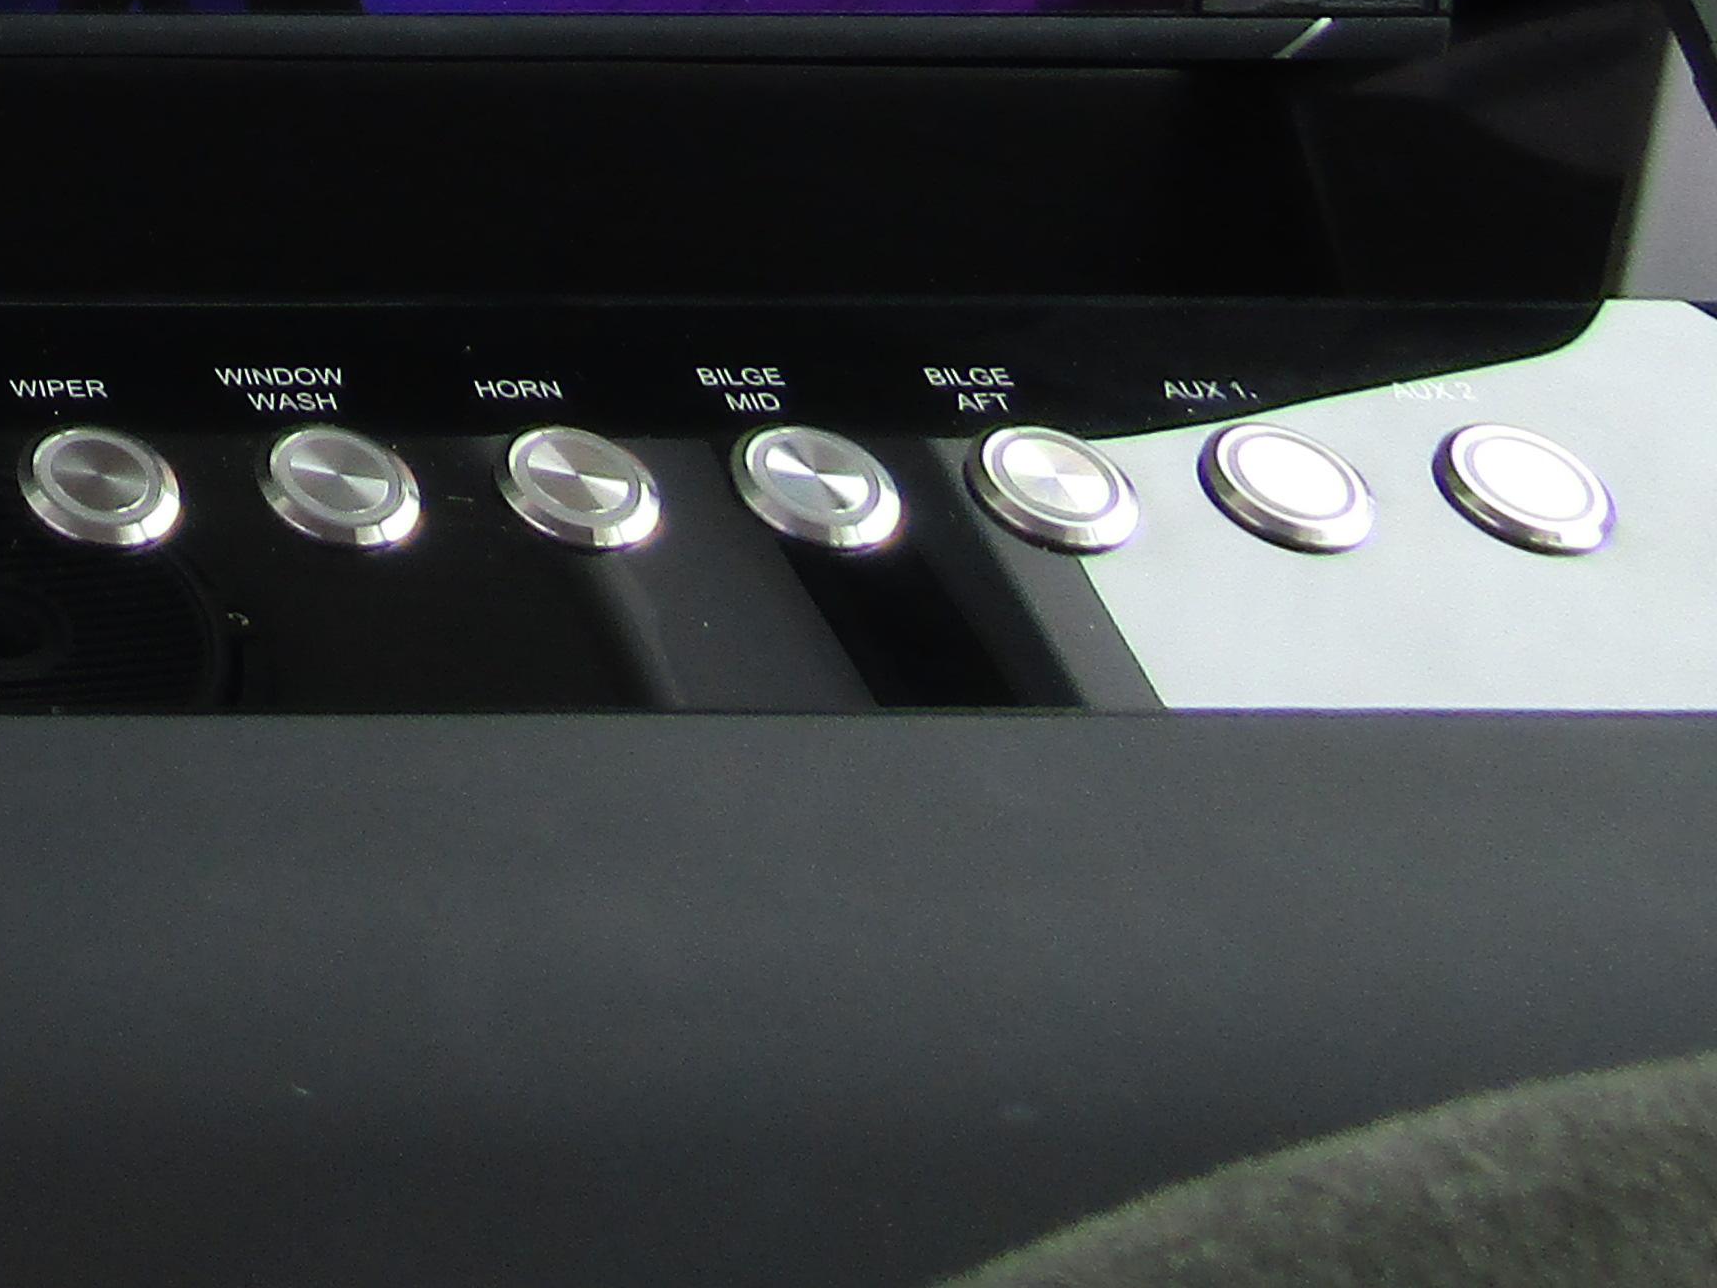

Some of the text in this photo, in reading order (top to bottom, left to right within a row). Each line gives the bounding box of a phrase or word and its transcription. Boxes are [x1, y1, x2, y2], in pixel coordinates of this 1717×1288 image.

[214, 367, 342, 386] WINDOW
[696, 367, 786, 386] BILGE
[923, 367, 1015, 386] BILGE
[9, 379, 108, 398] WIPER
[474, 379, 563, 399] HORN
[1164, 380, 1226, 400] AUX
[1392, 381, 1477, 401] AUX 2
[246, 392, 338, 411] WASH
[724, 392, 781, 411] MID
[957, 392, 1008, 412] AFT
